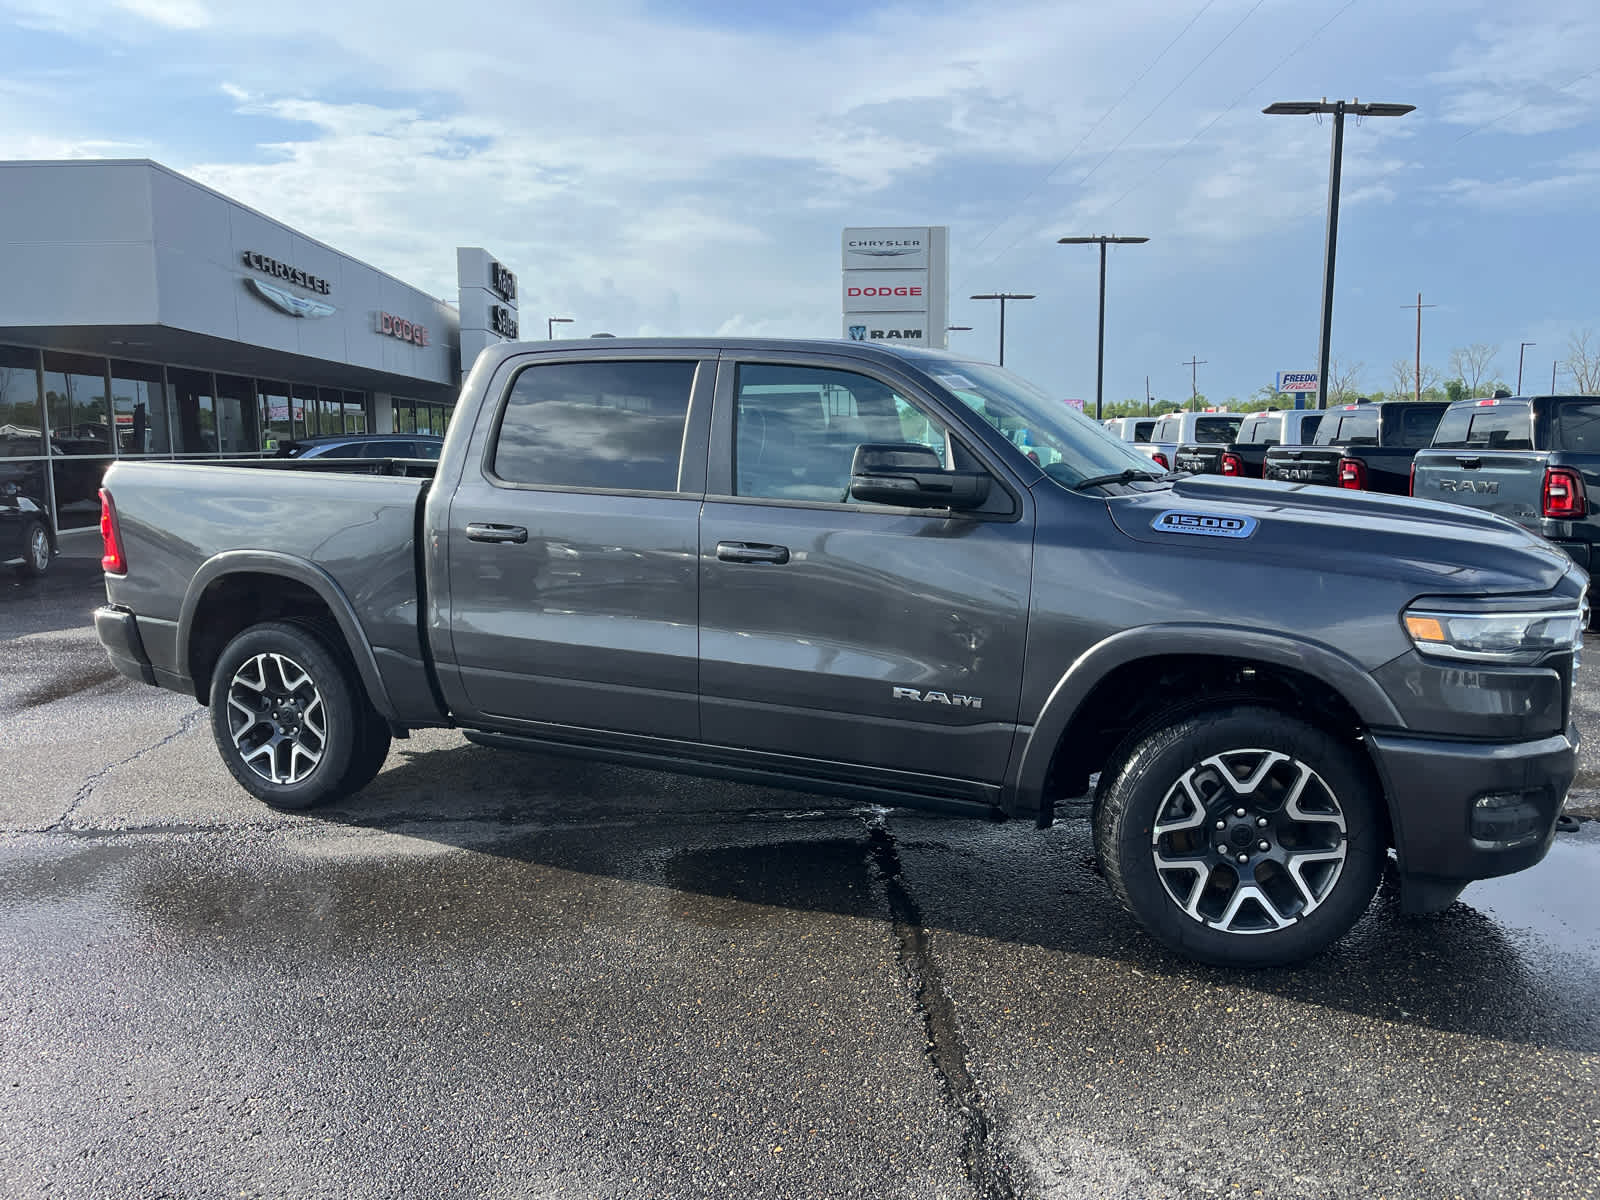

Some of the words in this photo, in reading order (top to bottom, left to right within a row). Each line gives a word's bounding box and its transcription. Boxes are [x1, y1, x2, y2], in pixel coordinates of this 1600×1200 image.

[243, 251, 331, 295] CHRYSLER
[848, 287, 922, 297] DODGE
[376, 311, 431, 347] DODGE
[870, 329, 922, 339] RAM
[1283, 373, 1318, 384] FREEDO
[1279, 468, 1313, 480] RAM
[1439, 478, 1499, 495] RAM
[1169, 515, 1241, 529] 1500
[892, 686, 983, 709] RAM
